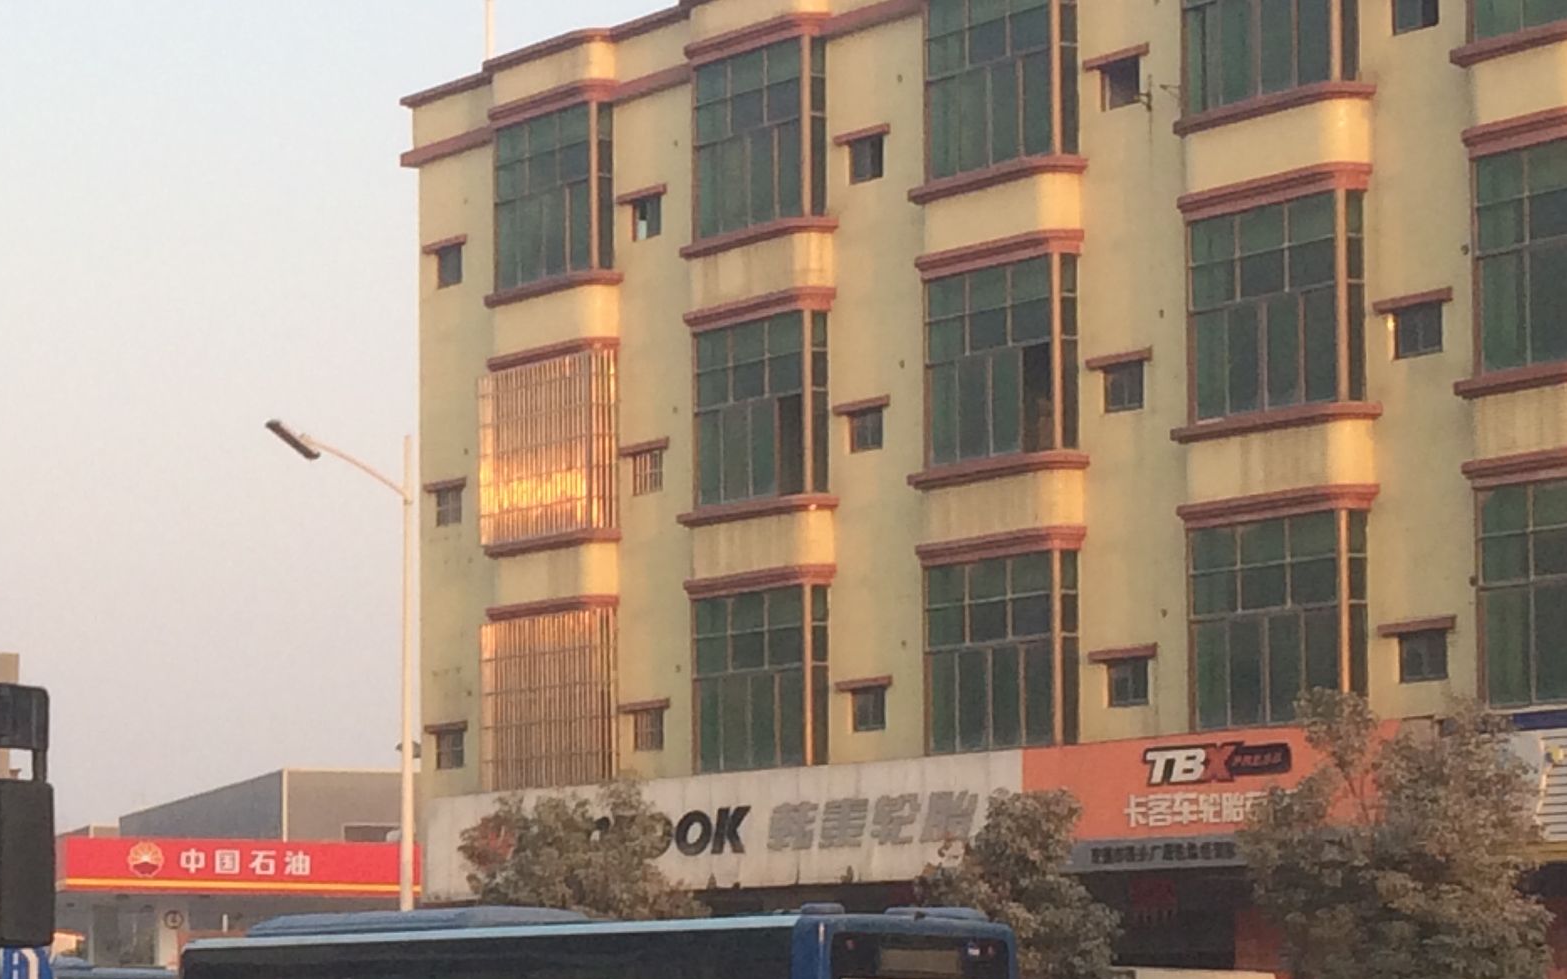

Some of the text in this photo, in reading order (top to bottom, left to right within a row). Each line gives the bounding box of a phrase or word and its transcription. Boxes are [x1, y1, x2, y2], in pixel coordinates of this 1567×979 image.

[1144, 743, 1238, 786] TBX
[179, 848, 312, 877] 中国石油
